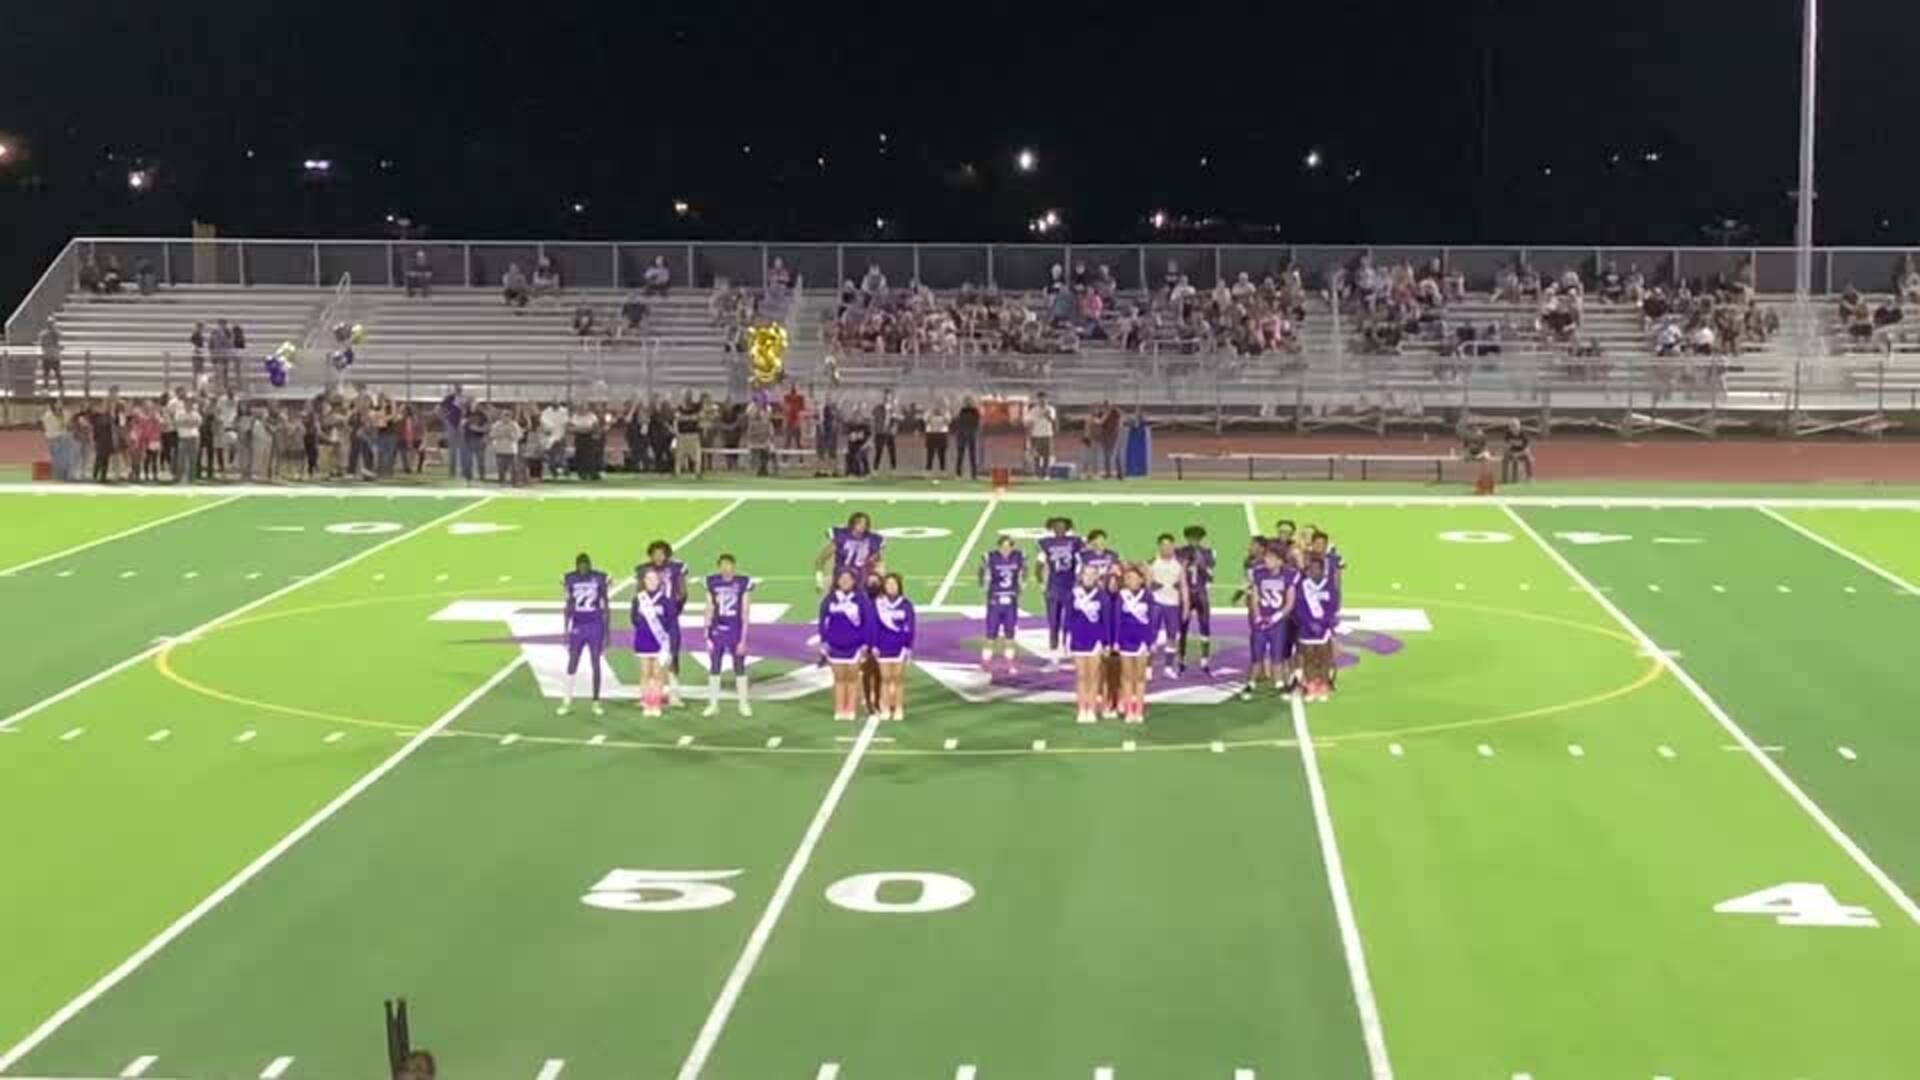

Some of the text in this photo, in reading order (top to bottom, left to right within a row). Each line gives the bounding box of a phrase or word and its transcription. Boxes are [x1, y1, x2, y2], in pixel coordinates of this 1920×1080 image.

[999, 569, 1013, 588] 3
[573, 587, 598, 612] 22
[715, 591, 738, 617] 12
[1713, 881, 1881, 928] 4
